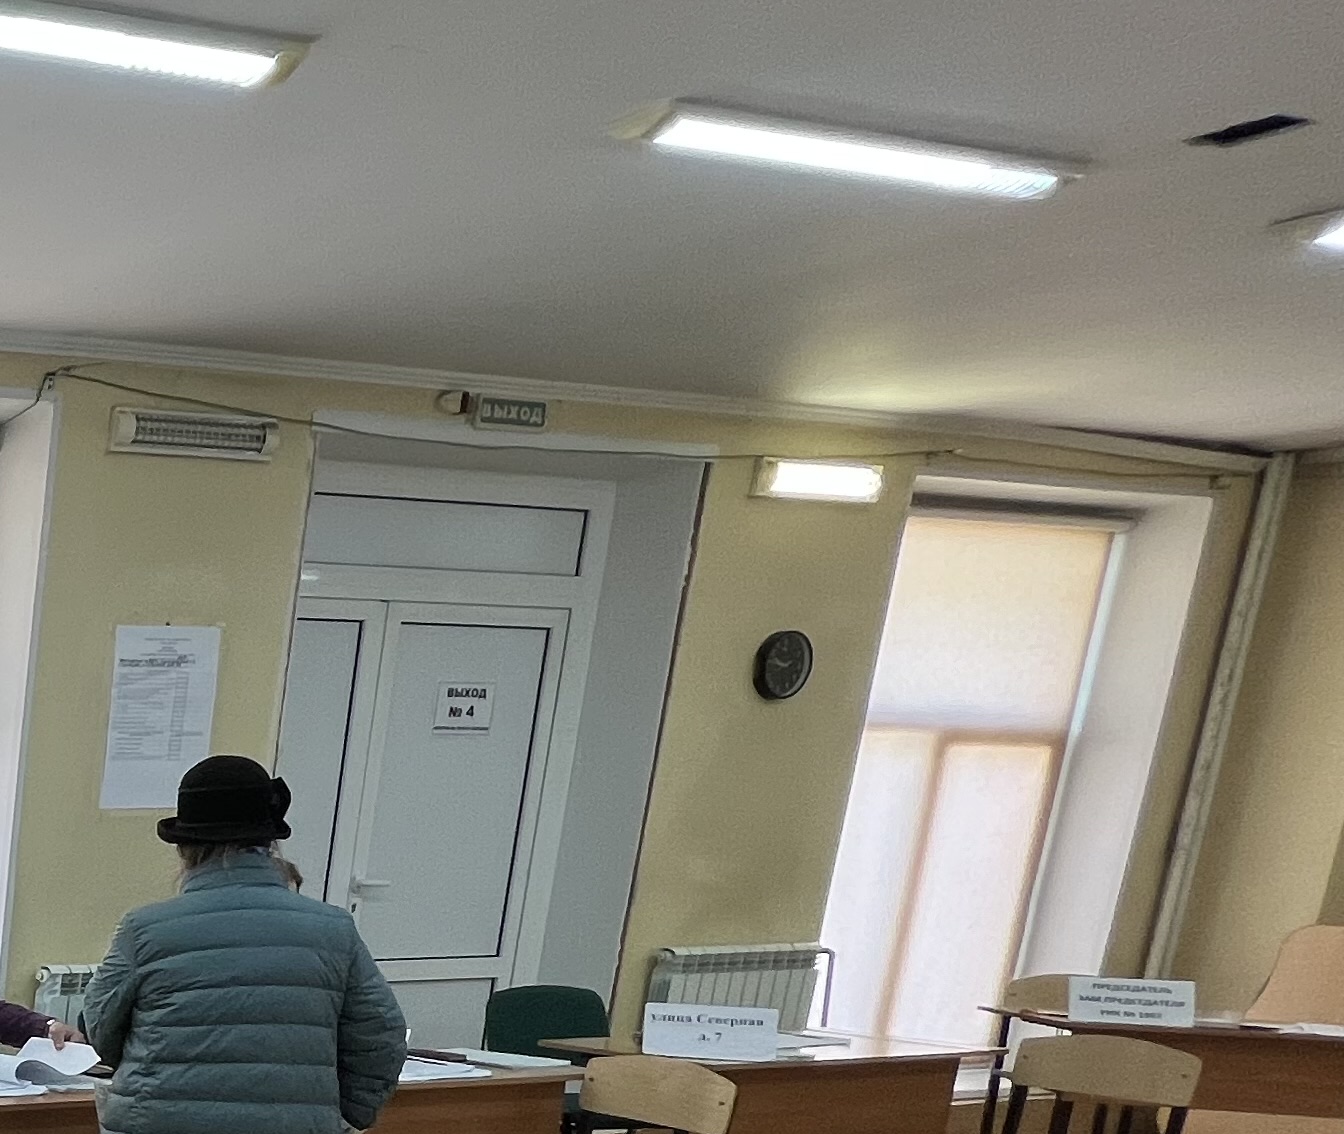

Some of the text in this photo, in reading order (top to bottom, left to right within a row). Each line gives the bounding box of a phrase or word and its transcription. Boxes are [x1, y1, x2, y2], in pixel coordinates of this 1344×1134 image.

[447, 688, 486, 699] ВЫХОД
[448, 705, 474, 717] № 4
[715, 1032, 722, 1041] 7
